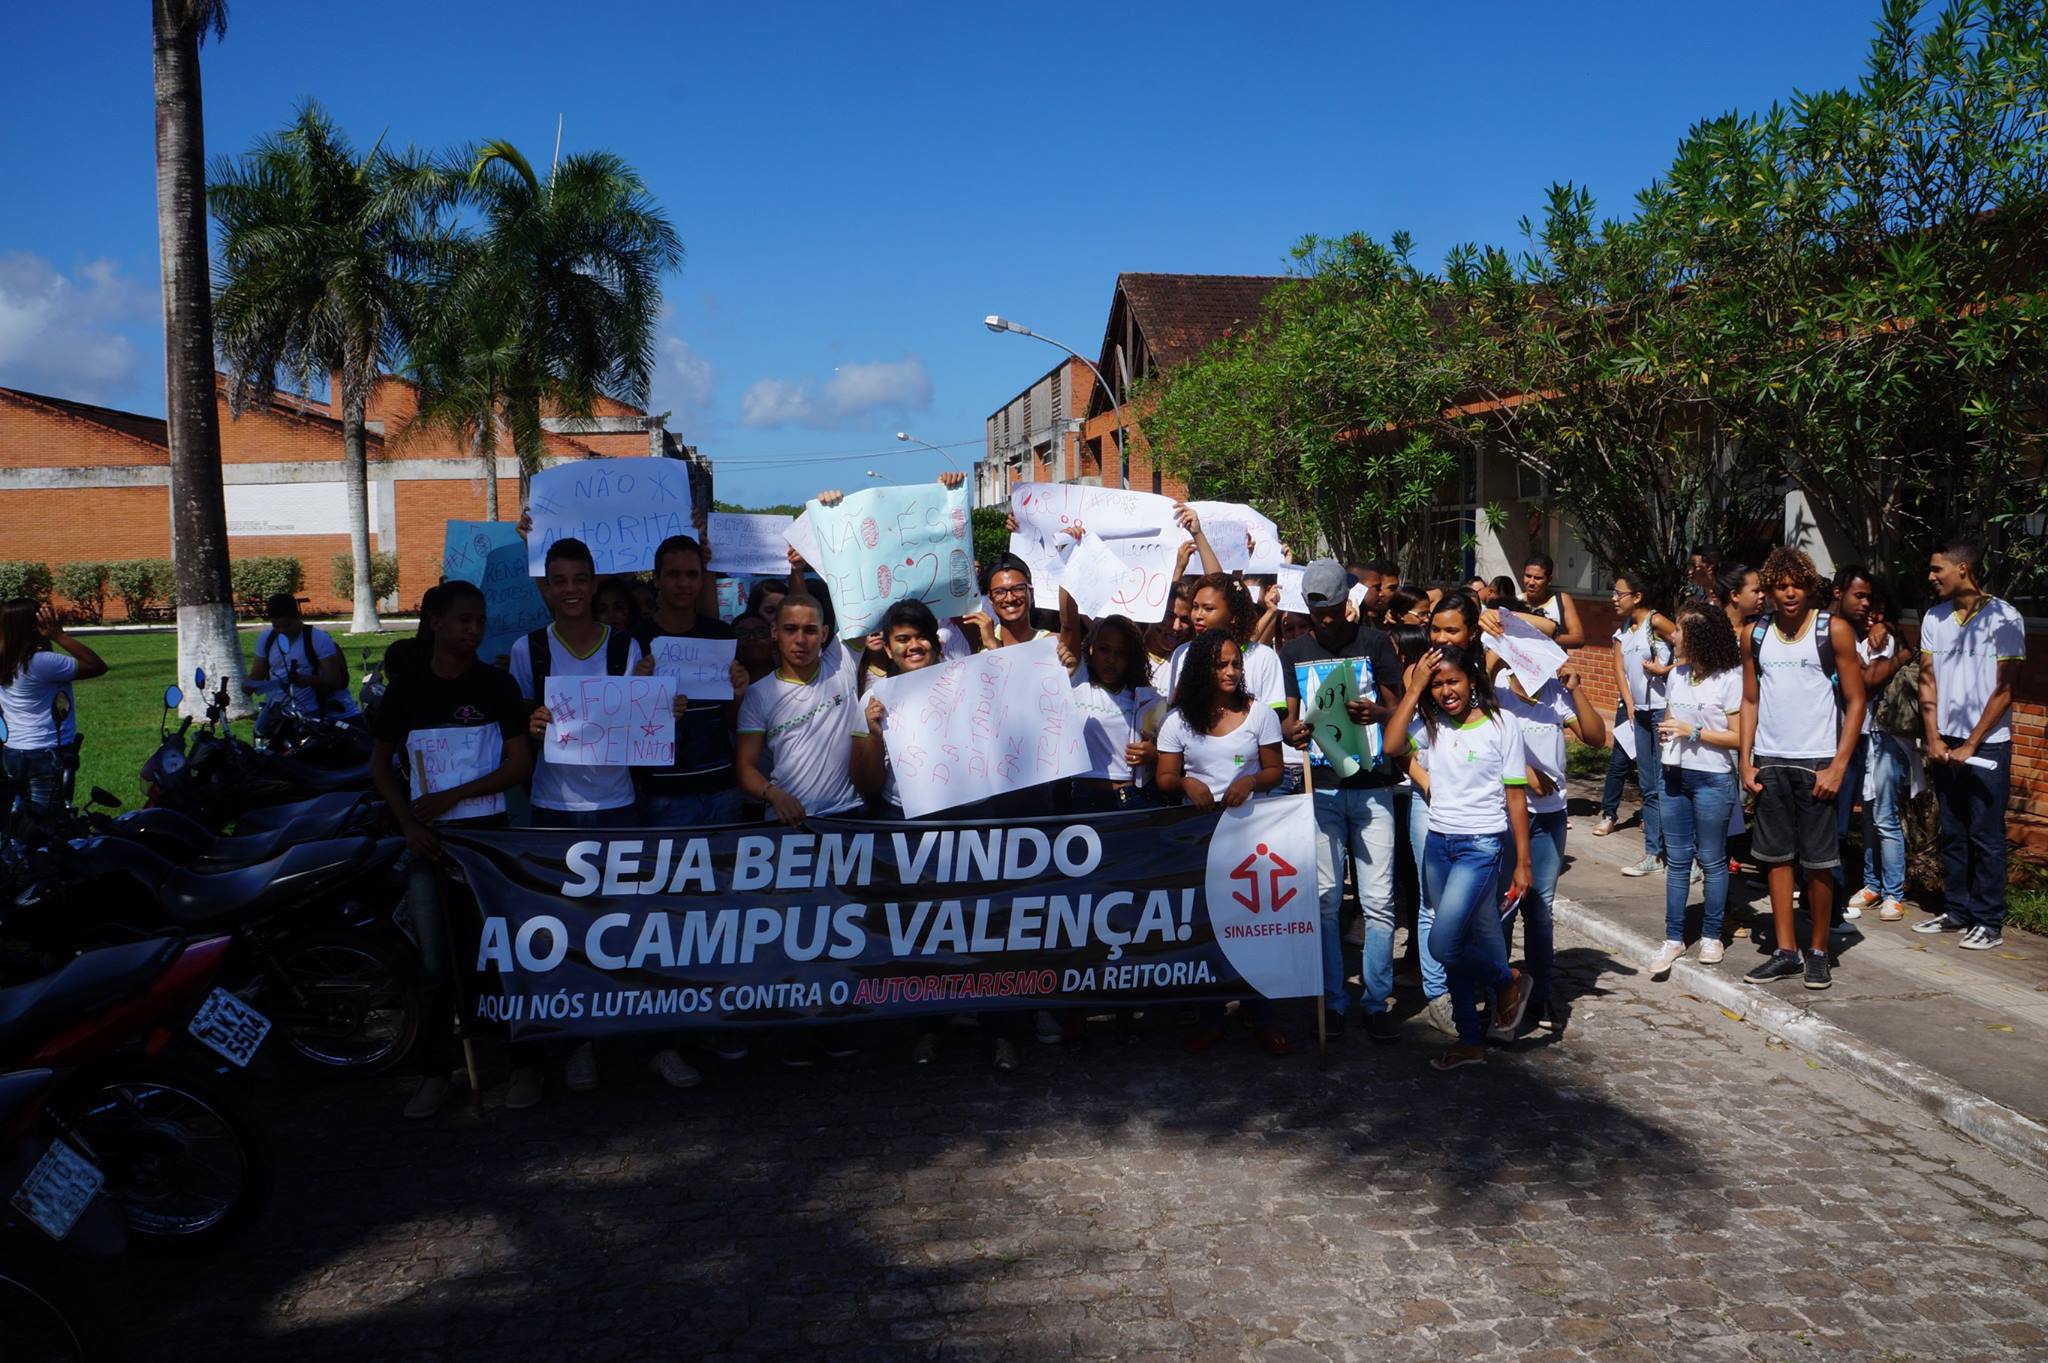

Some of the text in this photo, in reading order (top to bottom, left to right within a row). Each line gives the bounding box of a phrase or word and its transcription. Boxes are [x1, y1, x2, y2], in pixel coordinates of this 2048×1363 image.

[575, 468, 635, 498] NÃO
[816, 507, 880, 553] NÃO
[658, 642, 700, 662] AQUI
[561, 824, 1102, 898] SEJA BEM VINDO
[476, 887, 1197, 973] AO CAMPUS VALENÇA!
[1224, 920, 1314, 939] SINASEFE-IFBA
[477, 960, 1217, 1021] AQUI NÓS LUTAMOS CONTRA O AUTORITARISMO DA REITORIA.
